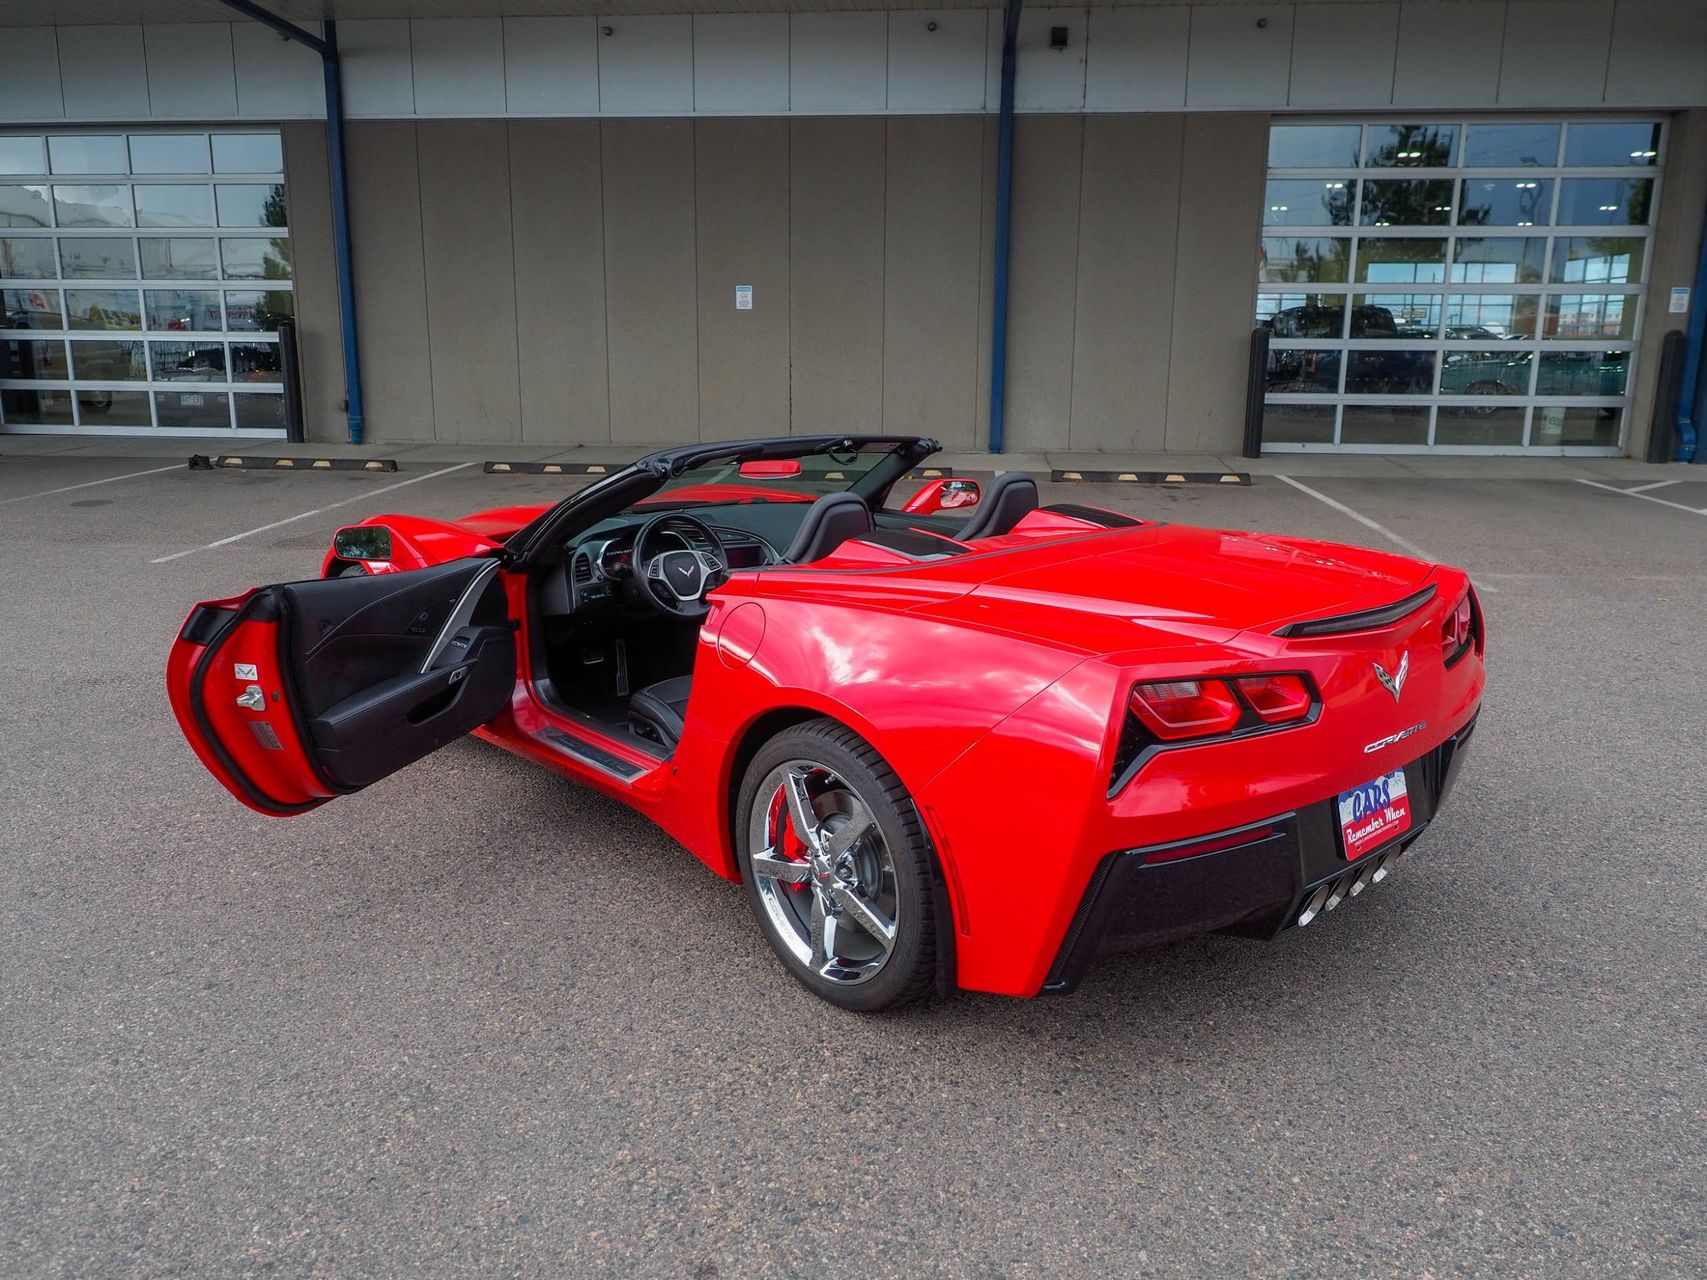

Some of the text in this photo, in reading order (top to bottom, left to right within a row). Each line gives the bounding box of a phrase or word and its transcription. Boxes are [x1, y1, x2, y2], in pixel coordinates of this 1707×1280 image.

[1364, 720, 1428, 753] CORVETTE
[1352, 779, 1391, 823] CARS
[1346, 816, 1384, 845] Remember
[1384, 806, 1406, 824] When
